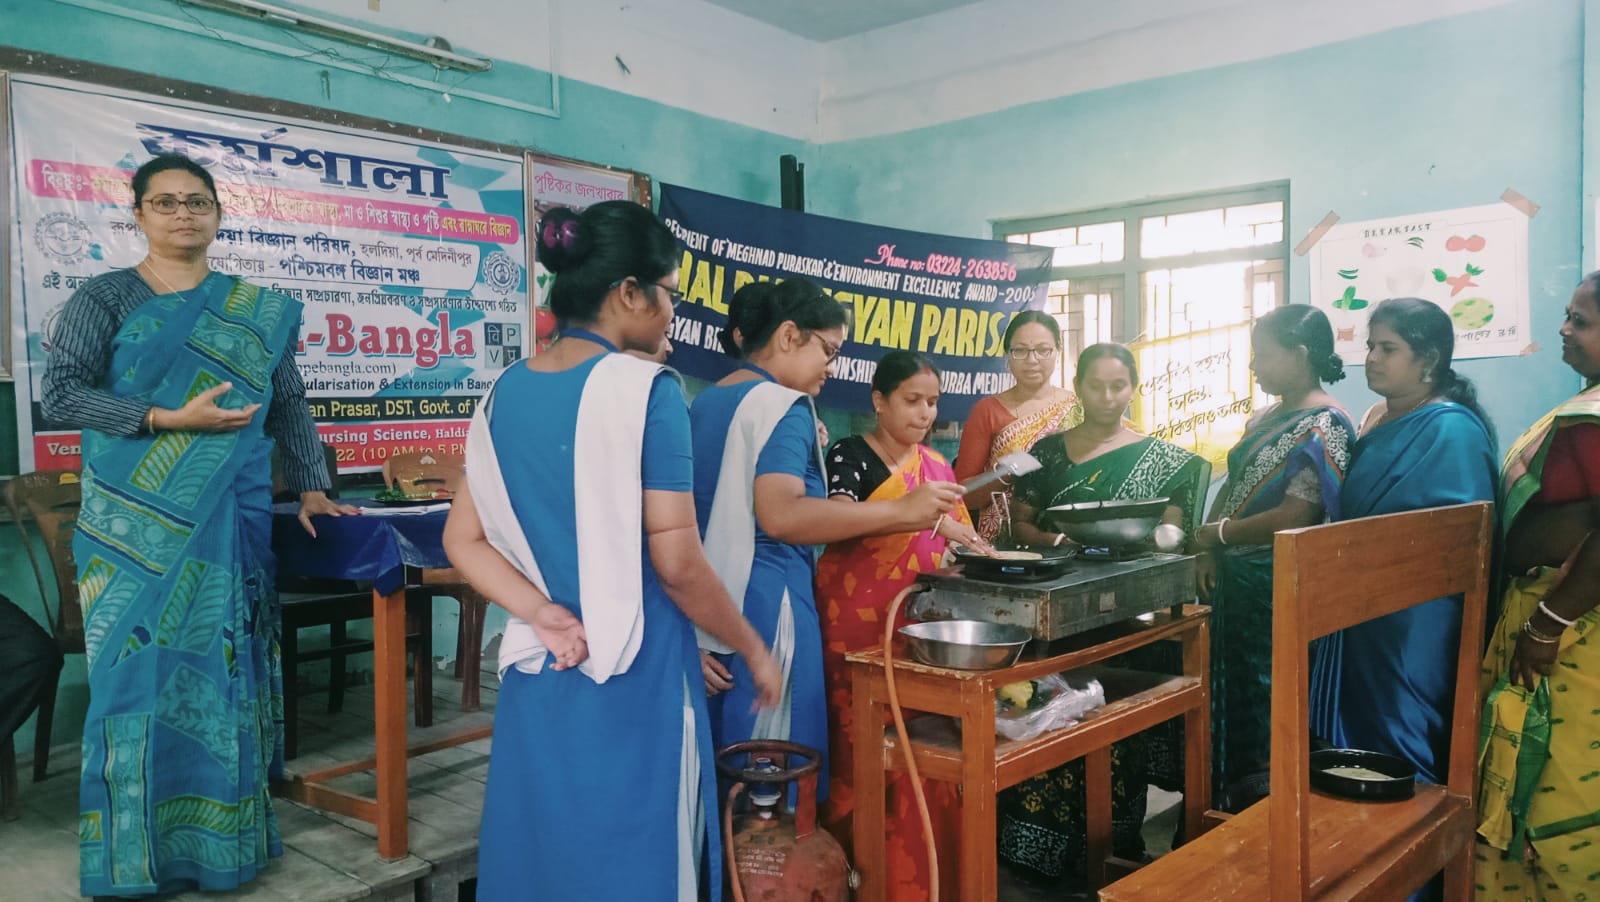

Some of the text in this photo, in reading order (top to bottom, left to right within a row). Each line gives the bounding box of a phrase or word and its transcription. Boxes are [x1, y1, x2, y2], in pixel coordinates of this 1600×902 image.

[535, 171, 572, 193] পুষ্টিকর
[413, 215, 420, 226] ও
[442, 218, 458, 232] এবং
[490, 217, 512, 238] বিজ্ঞান
[248, 226, 297, 251] বিজ্ঞান
[303, 232, 355, 257] পরিষদ,
[406, 245, 424, 265] পূর্ব
[426, 248, 472, 267] মেদিনীপুর
[279, 255, 346, 279] পশ্চিমবঙ্গ
[351, 259, 393, 282] বিজ্ঞান
[398, 268, 420, 284] মঞ্চ
[712, 238, 726, 256] OF
[902, 274, 962, 300] EXCELLENCE
[864, 243, 909, 270] Phone
[926, 253, 1017, 281] 03224-263856
[507, 328, 516, 341] P
[490, 350, 498, 363] V
[306, 377, 374, 391] ularisation
[379, 378, 390, 390] &
[394, 378, 450, 391] Extension
[454, 378, 463, 390] in
[941, 370, 972, 394] URBA
[331, 400, 381, 417] Prasar,
[385, 400, 415, 417] DST,
[420, 400, 453, 414] Govt.
[458, 399, 470, 413] of
[320, 430, 367, 444] ursing
[374, 429, 431, 441] Science,
[47, 442, 81, 456] Ven
[336, 448, 355, 461] 22
[362, 447, 387, 462] (10
